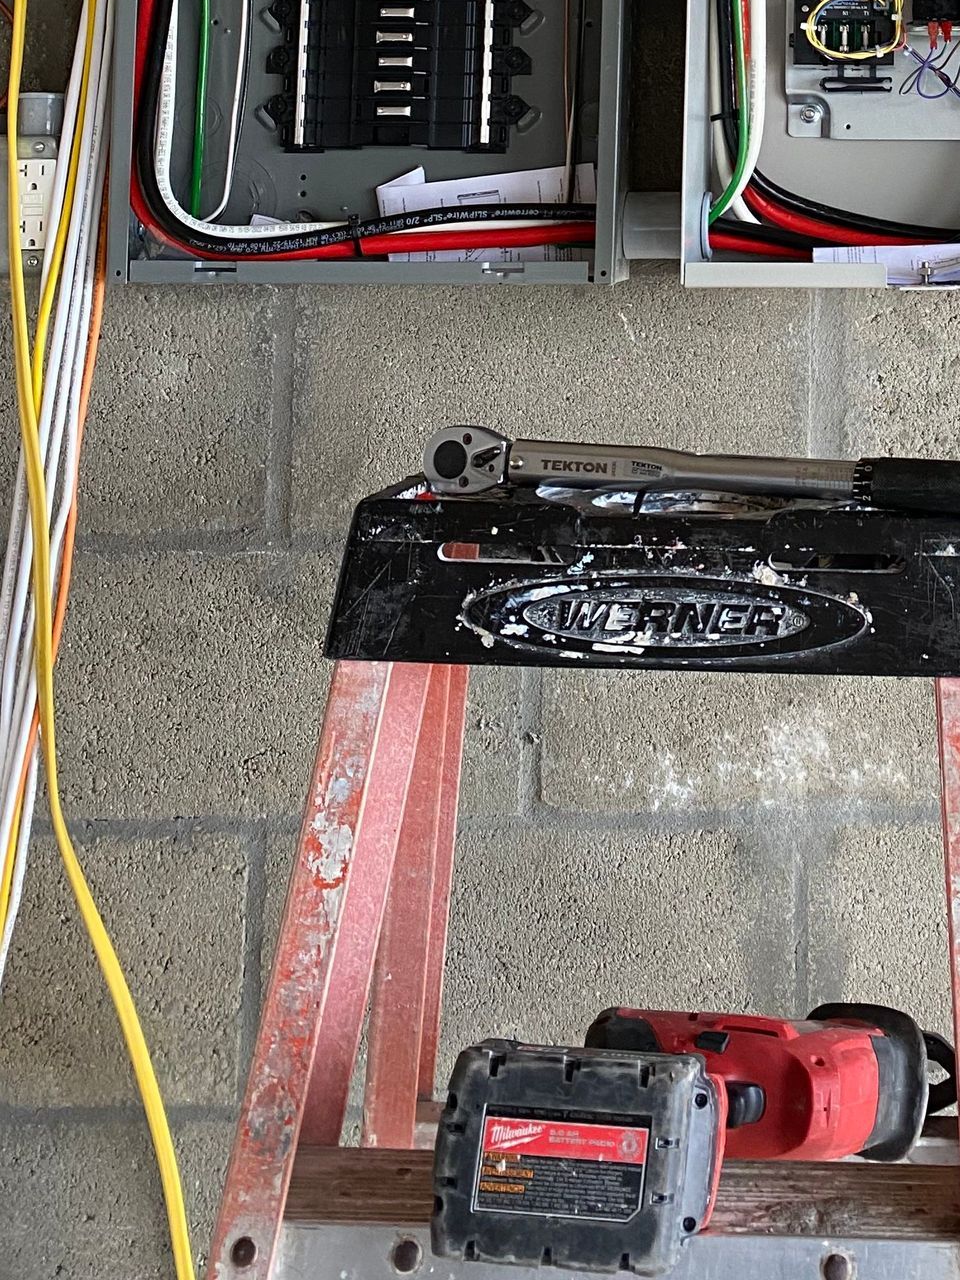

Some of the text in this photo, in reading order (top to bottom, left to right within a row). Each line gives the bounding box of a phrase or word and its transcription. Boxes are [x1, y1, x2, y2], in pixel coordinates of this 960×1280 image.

[541, 459, 607, 474] TEKTON
[631, 460, 662, 471] TEKTON
[558, 598, 788, 638] WERNER
[491, 1122, 547, 1144] Milwaukee
